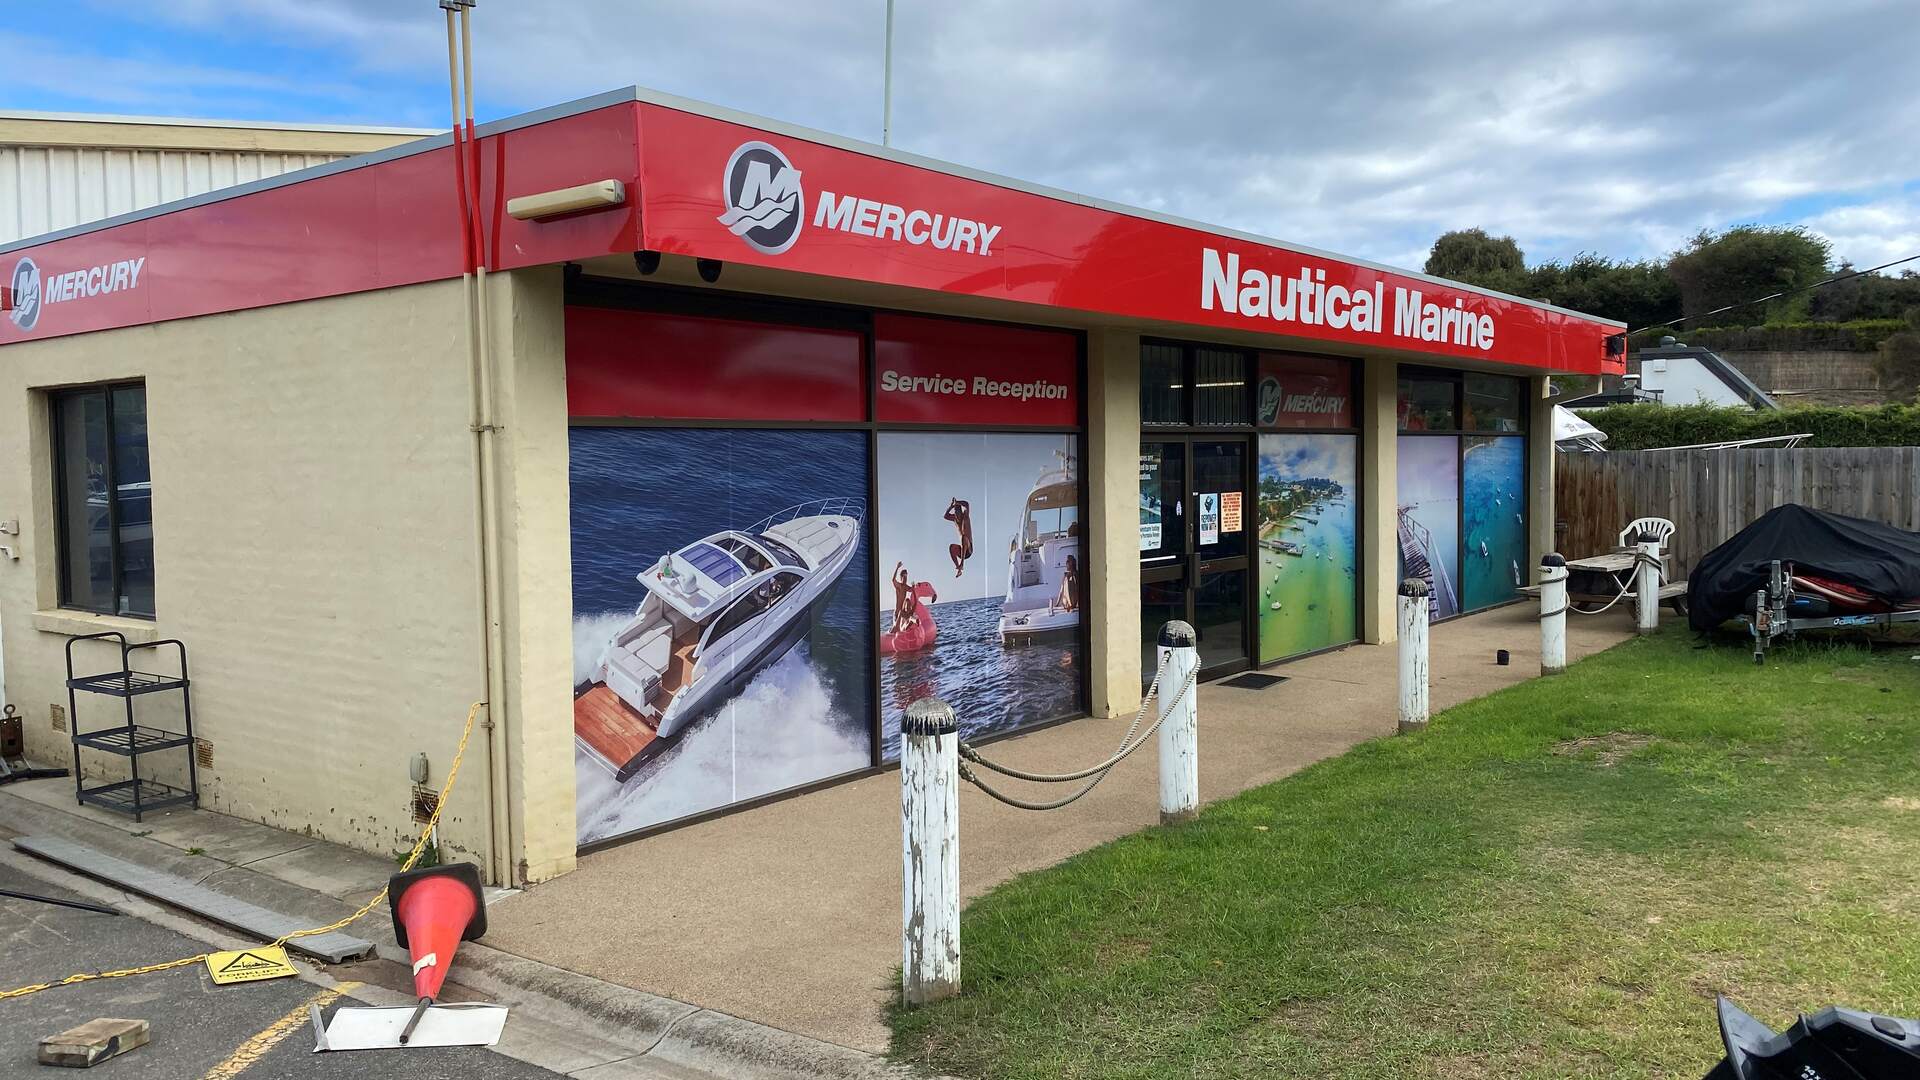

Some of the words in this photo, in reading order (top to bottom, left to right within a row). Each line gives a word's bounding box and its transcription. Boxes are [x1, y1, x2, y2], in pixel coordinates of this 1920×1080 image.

[813, 190, 1002, 256] MERCURY
[45, 257, 145, 304] MERCURY
[1200, 247, 1384, 333] Nautical
[1393, 286, 1495, 350] Marine
[881, 370, 966, 395] Service
[972, 376, 1068, 402] Reception
[1283, 394, 1346, 413] MERCURY
